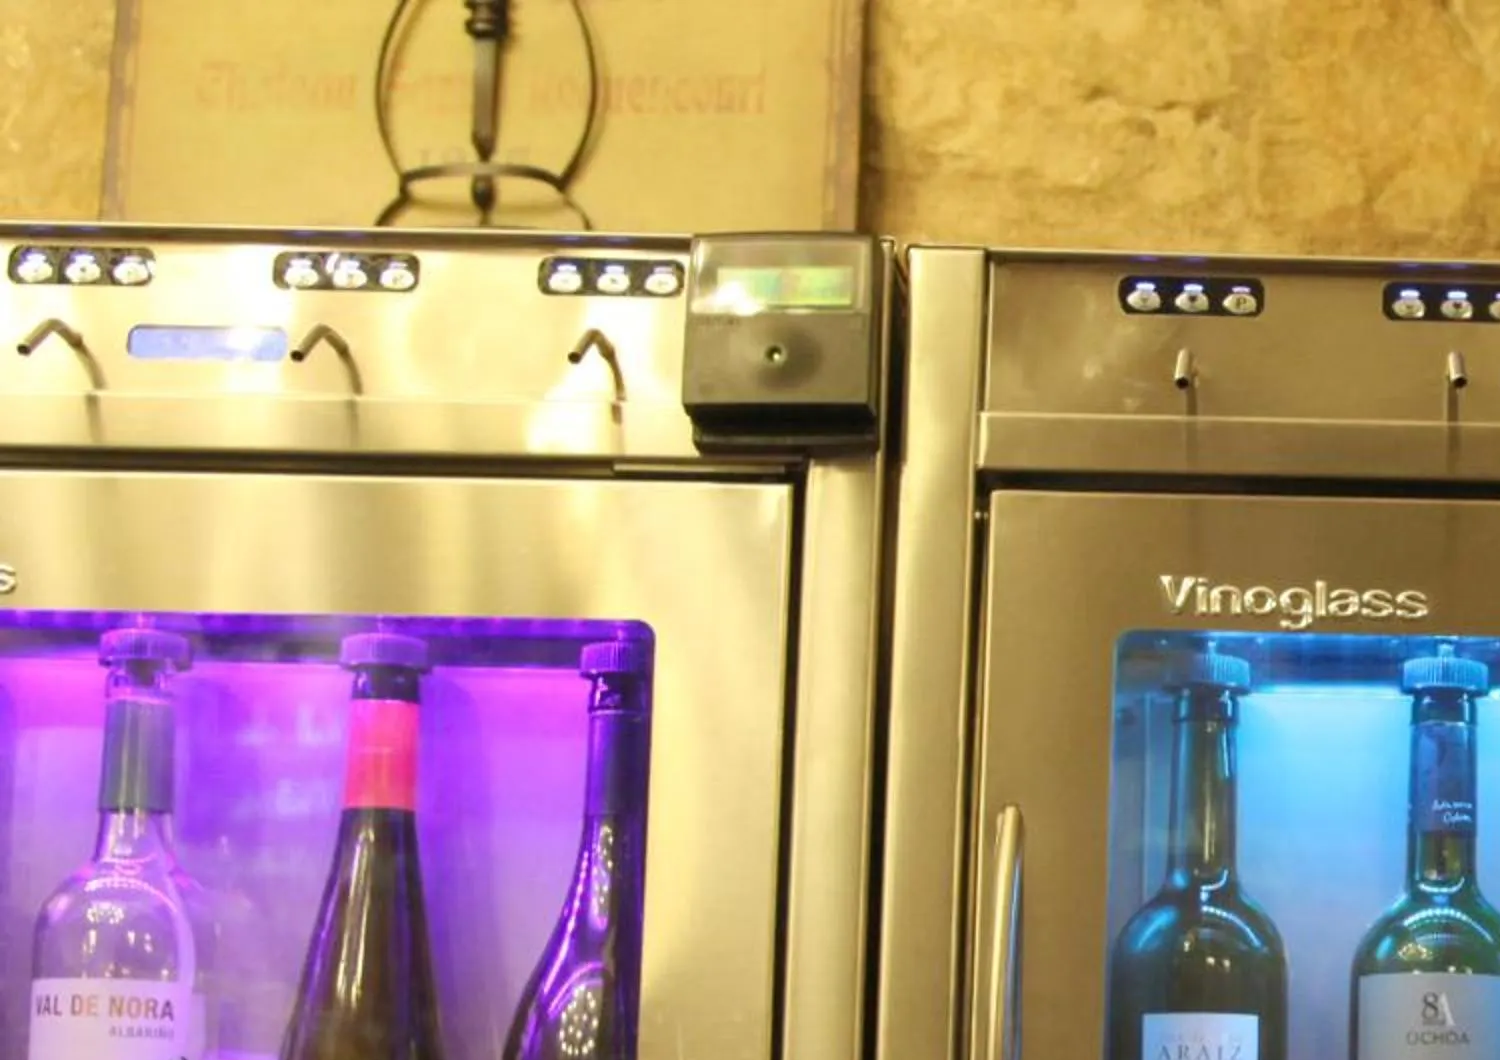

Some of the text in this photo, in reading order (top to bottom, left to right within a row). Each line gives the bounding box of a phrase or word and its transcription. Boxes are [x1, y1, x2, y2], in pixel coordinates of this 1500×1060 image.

[1160, 575, 1429, 630] Vinoglass
[70, 995, 99, 1017] DE
[108, 995, 175, 1021] NORA
